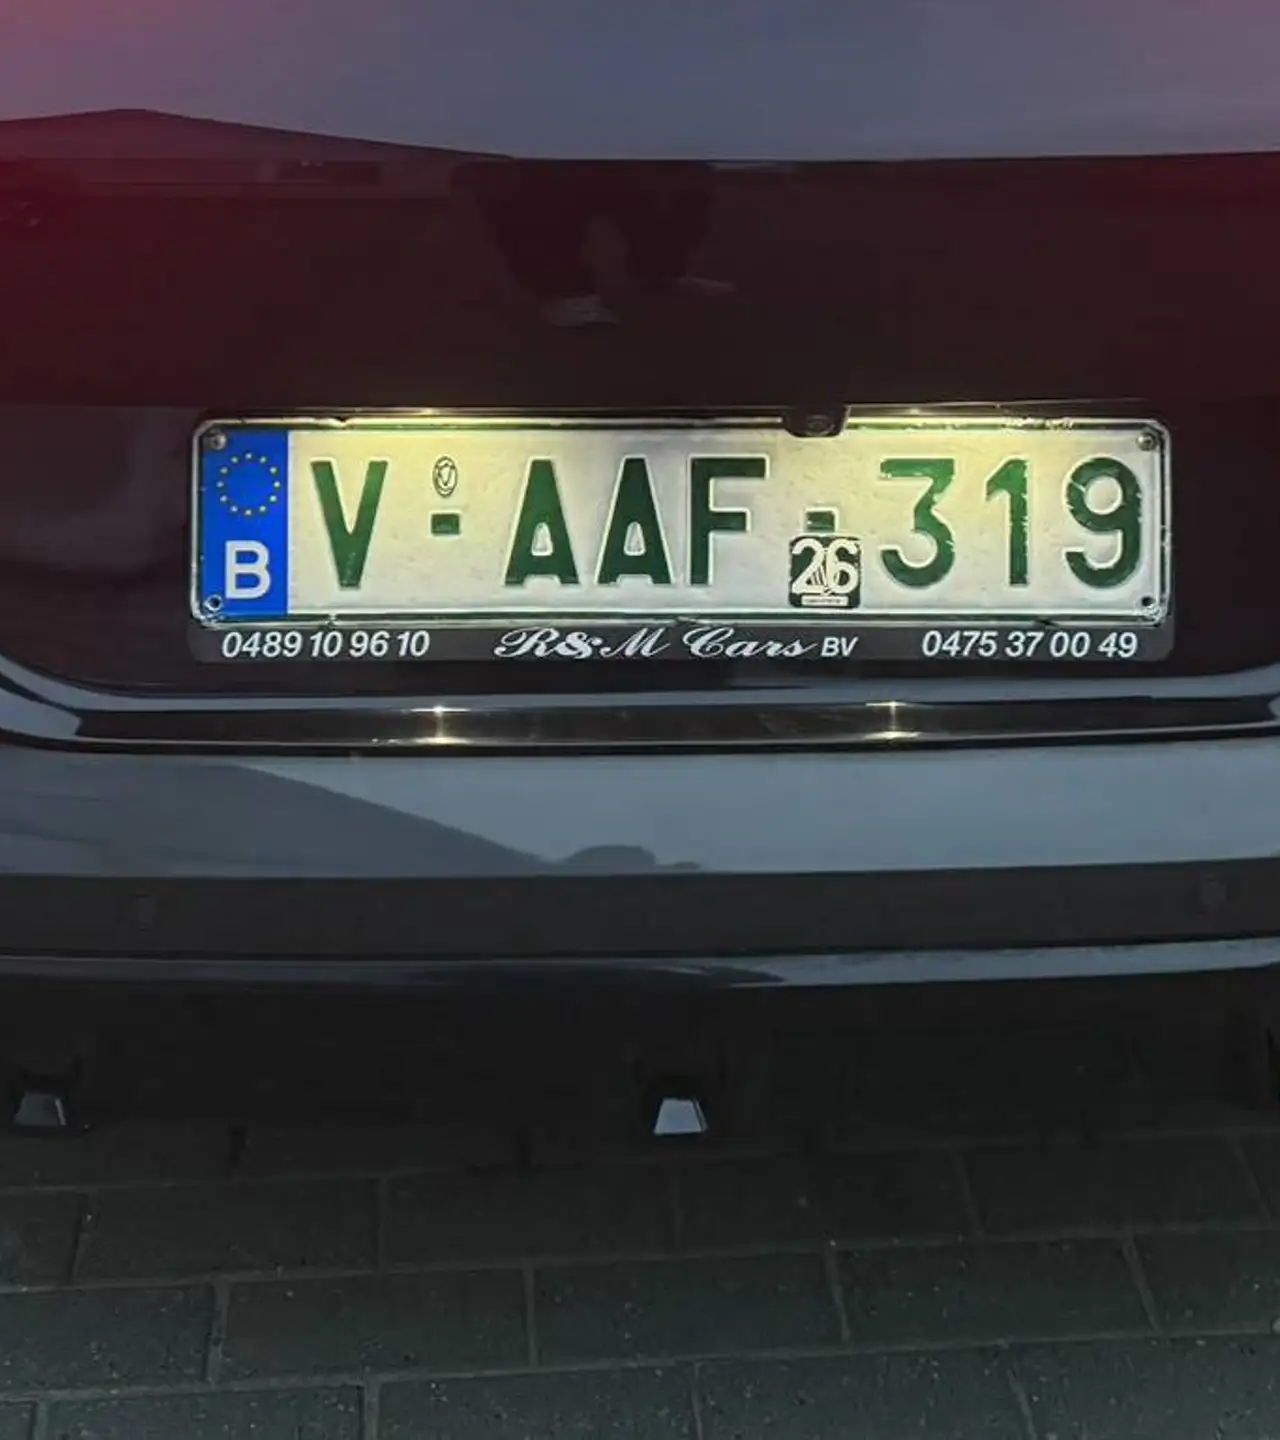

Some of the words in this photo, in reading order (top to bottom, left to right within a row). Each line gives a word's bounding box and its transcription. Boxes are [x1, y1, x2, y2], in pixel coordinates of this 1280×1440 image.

[224, 540, 272, 600] B
[791, 538, 858, 595] 26
[221, 631, 302, 658] 0489
[310, 631, 342, 658] 10
[349, 631, 390, 658] 96
[397, 631, 431, 658] 10
[683, 626, 818, 659] Cars
[821, 636, 859, 658] BV
[921, 631, 998, 658] 0475
[1005, 631, 1045, 658] 37
[1049, 631, 1090, 658] 00
[1098, 631, 1139, 658] 49
